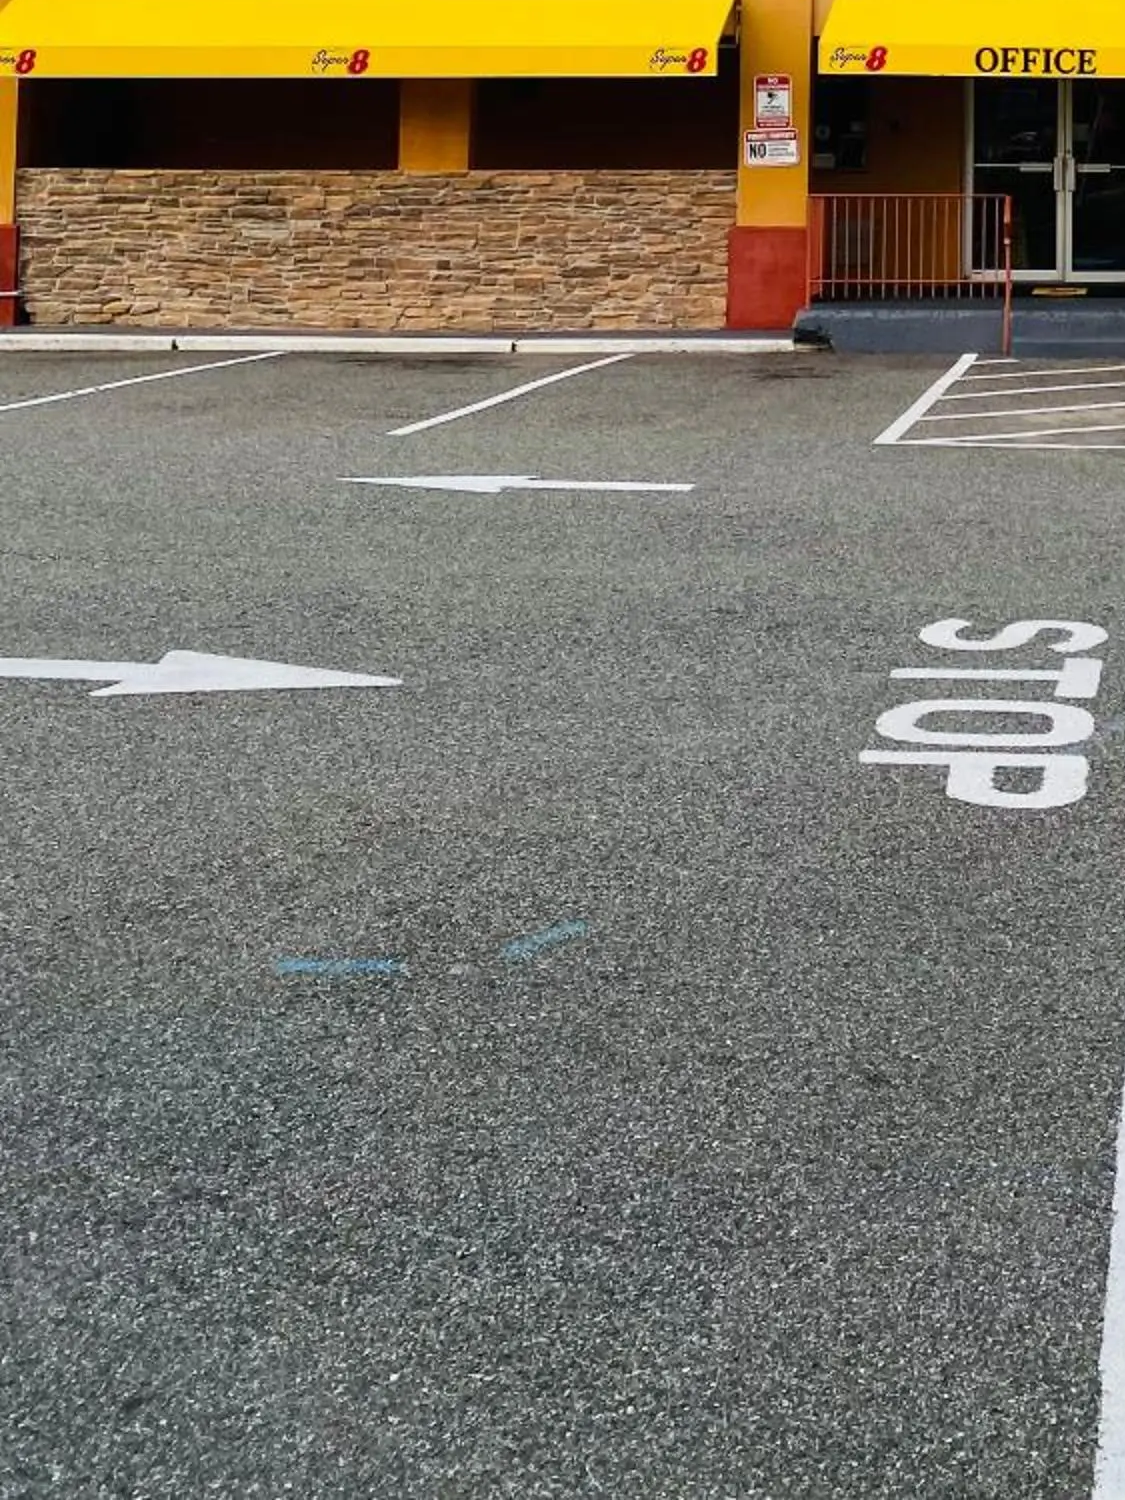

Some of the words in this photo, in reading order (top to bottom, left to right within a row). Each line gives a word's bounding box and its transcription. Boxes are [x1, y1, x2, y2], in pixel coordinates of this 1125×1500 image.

[15, 49, 37, 74] 8
[311, 49, 349, 72] Super
[348, 49, 370, 75] 8
[650, 48, 687, 71] Super
[687, 47, 708, 73] 8
[830, 47, 867, 68] Super
[865, 46, 888, 72] 8
[974, 47, 1098, 75] OFFICE
[749, 143, 767, 158] NO
[858, 617, 1109, 809] STOP
